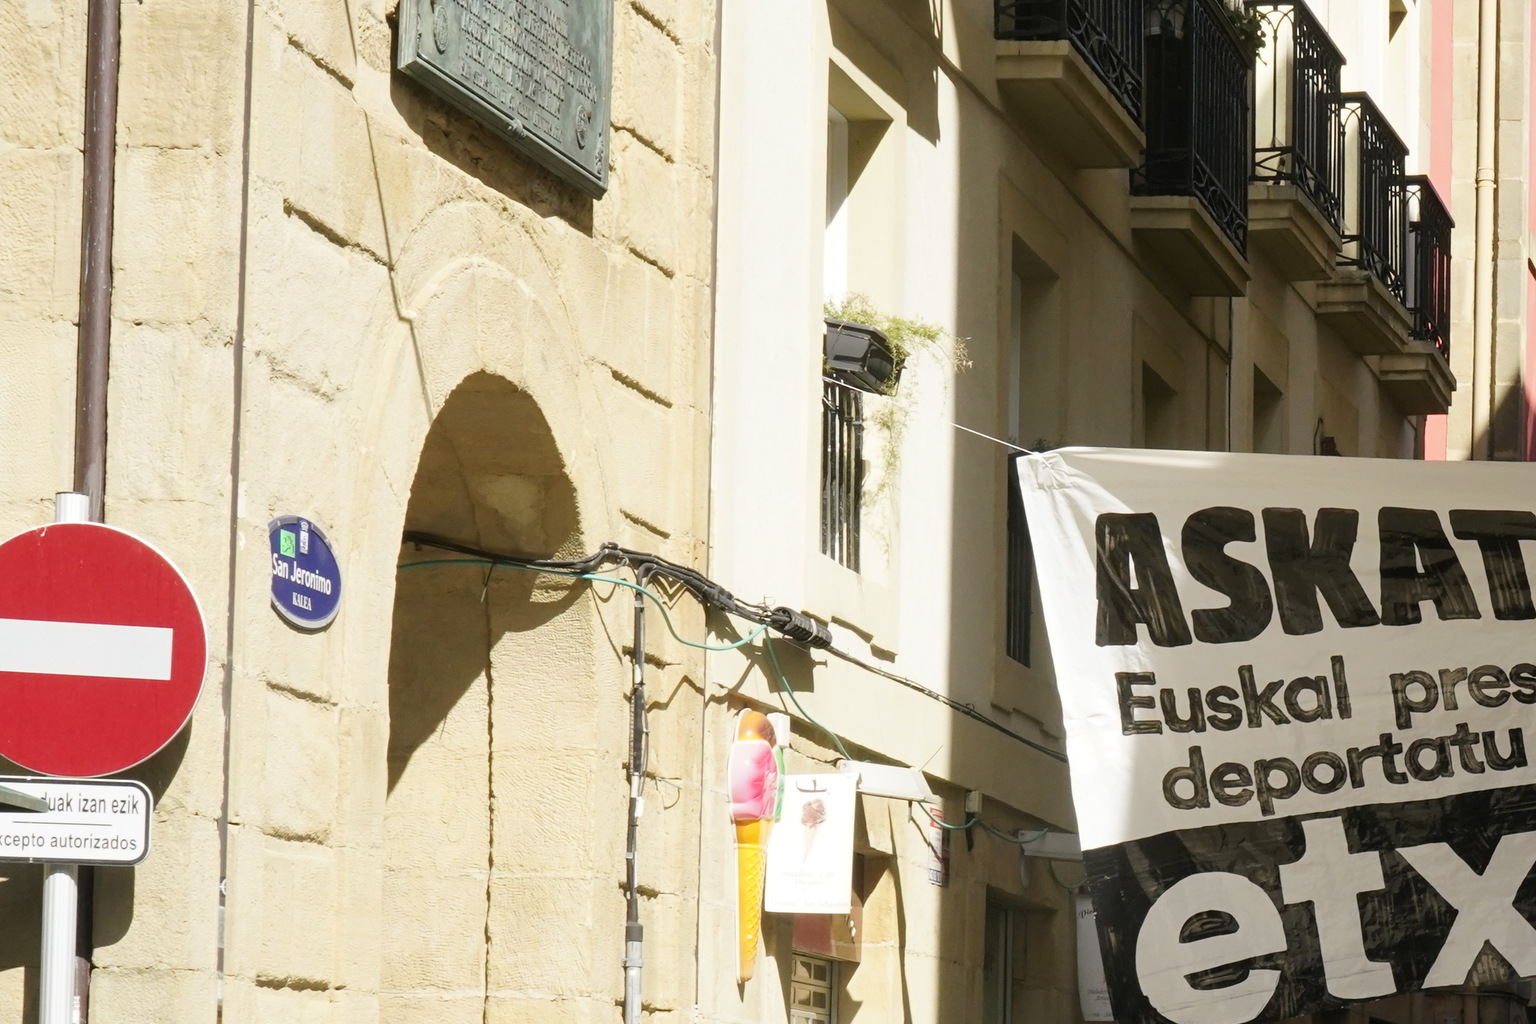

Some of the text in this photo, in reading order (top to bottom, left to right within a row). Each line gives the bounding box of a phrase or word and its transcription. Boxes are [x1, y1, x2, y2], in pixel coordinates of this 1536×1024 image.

[272, 552, 332, 595] San Jeronimo
[292, 592, 312, 611] KALEA
[1115, 655, 1352, 736] Euskal
[1162, 722, 1529, 816] deportatu
[78, 793, 107, 814] izan
[111, 795, 139, 815] ezik
[50, 834, 137, 850] autorizados
